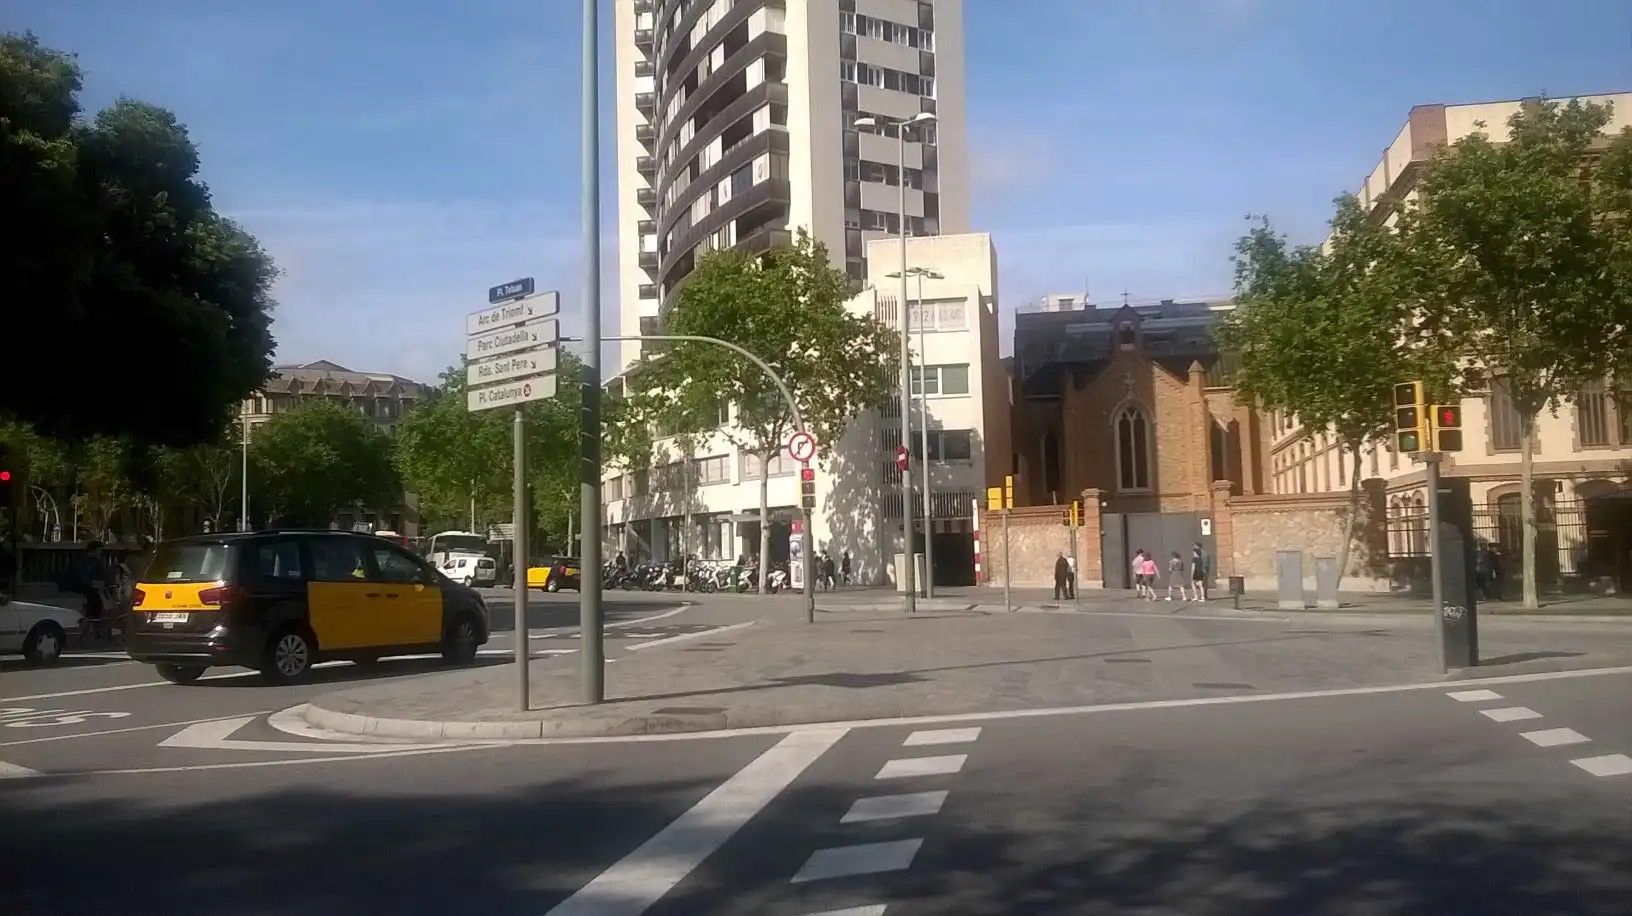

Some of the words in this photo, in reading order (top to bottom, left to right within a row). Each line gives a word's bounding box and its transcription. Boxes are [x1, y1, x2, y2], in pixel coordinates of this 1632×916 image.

[478, 314, 490, 326] Arc
[491, 311, 500, 322] de
[502, 304, 524, 320] Triomf
[478, 339, 493, 352] Parc
[494, 330, 528, 347] Ciutadella
[494, 361, 510, 374] Sant
[511, 358, 528, 371] Pere
[488, 387, 523, 402] Catalunya
